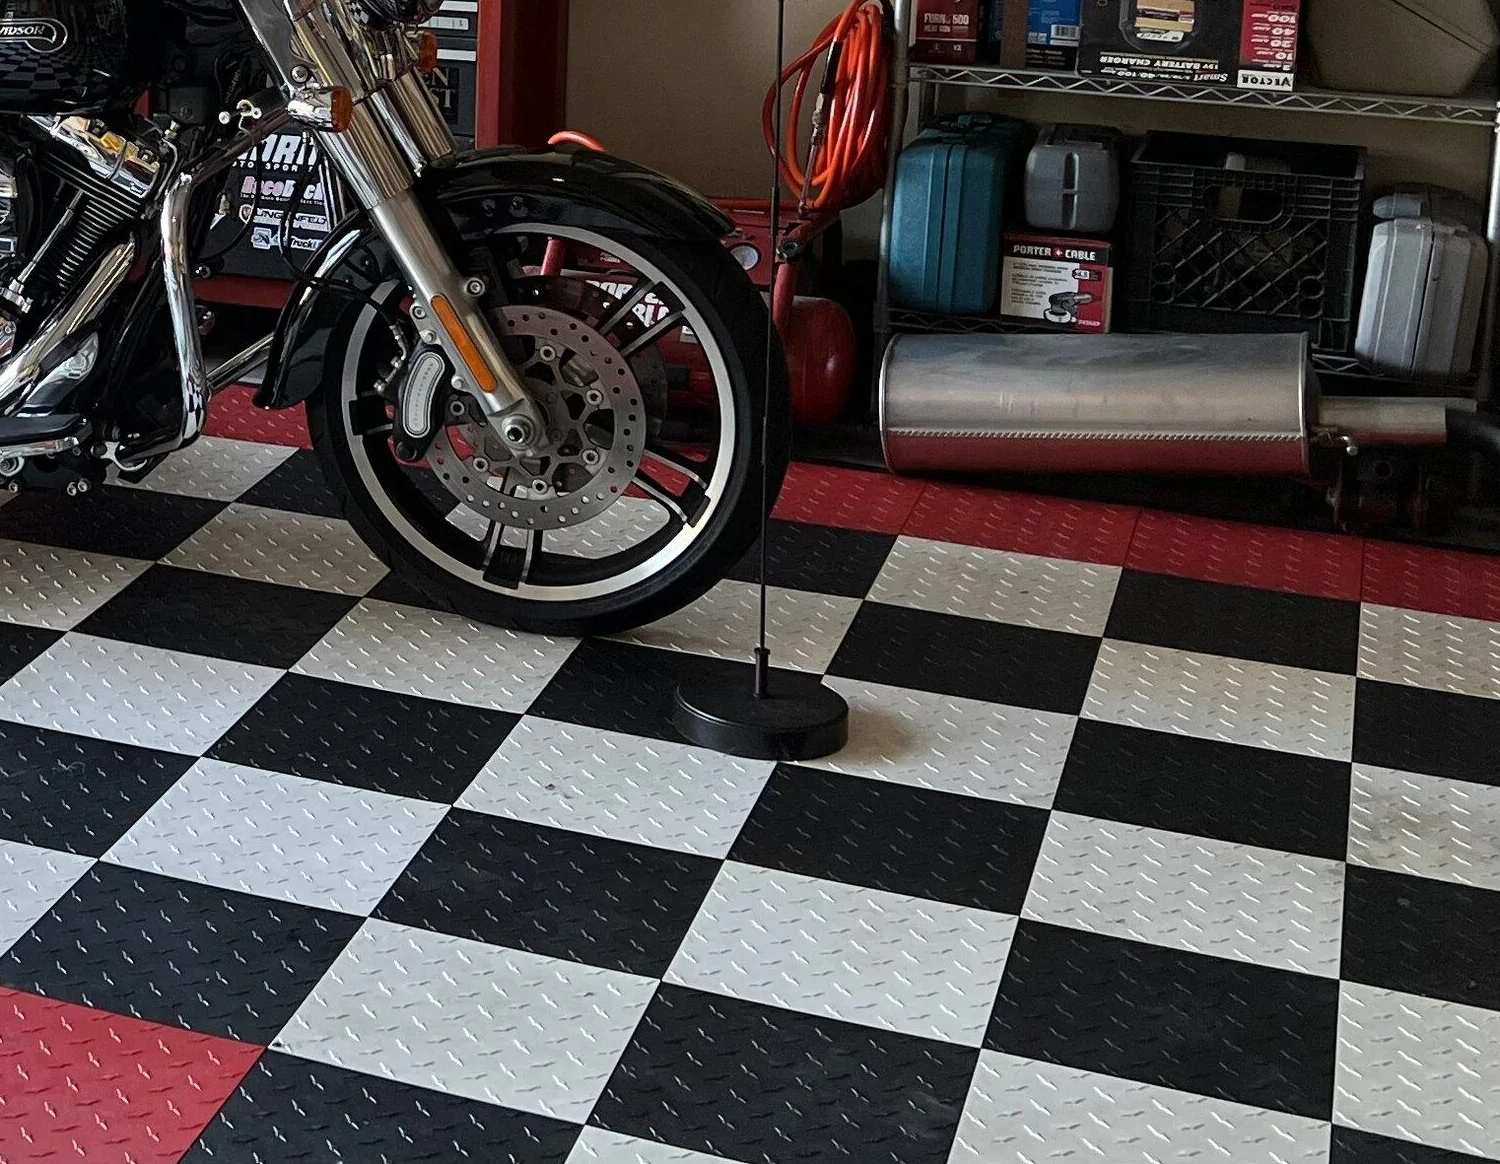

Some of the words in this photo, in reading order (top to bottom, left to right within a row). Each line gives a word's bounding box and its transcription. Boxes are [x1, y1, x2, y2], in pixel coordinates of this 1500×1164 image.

[1268, 14, 1296, 24] 100
[1270, 39, 1294, 48] 20
[1100, 56, 1151, 66] CHARGER
[1275, 52, 1294, 61] 10
[1153, 59, 1201, 69] BATTERY
[1193, 73, 1228, 82] Smart
[1242, 74, 1291, 87] VECTOR
[1013, 244, 1052, 257] PORTER
[1065, 249, 1097, 261] CABLE
